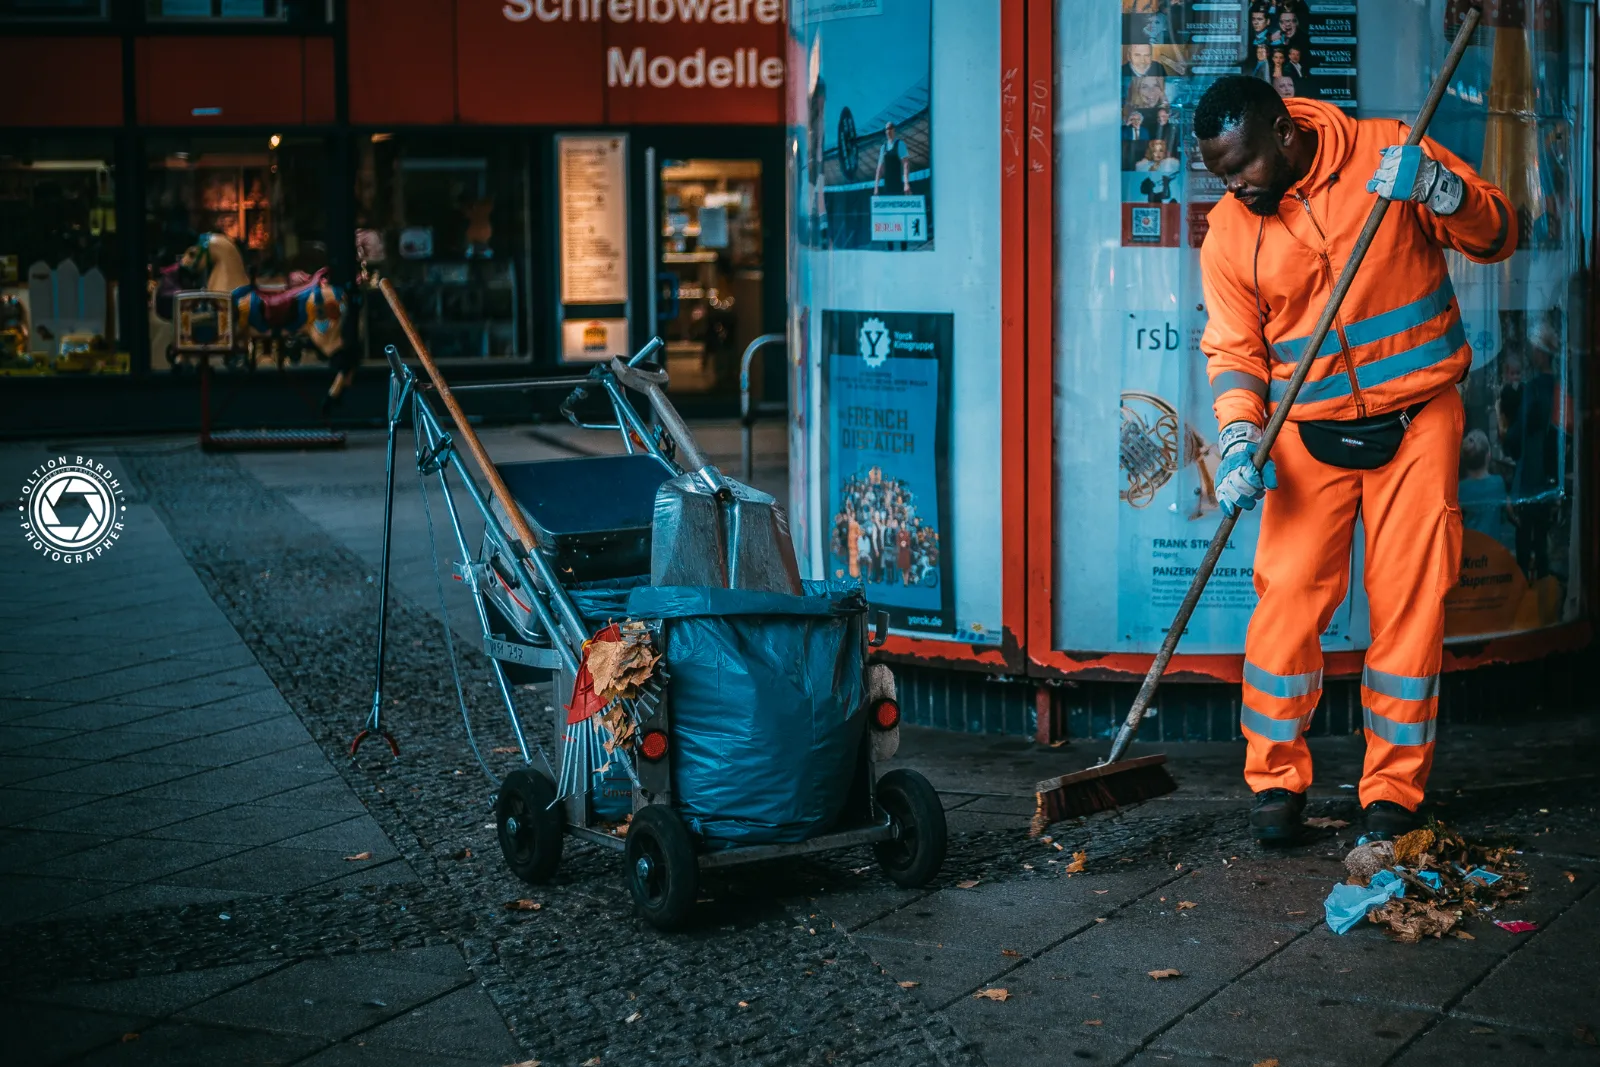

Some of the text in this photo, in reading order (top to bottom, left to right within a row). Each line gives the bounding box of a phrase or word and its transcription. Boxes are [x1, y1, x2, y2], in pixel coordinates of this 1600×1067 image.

[502, 0, 786, 24] Schreibware
[607, 47, 784, 88] Modelle
[1136, 322, 1180, 350] rsb
[847, 406, 909, 431] FRENCH
[842, 428, 915, 454] DISPATCH
[1152, 538, 1188, 549] FRANK
[907, 615, 942, 627] yorck.de
